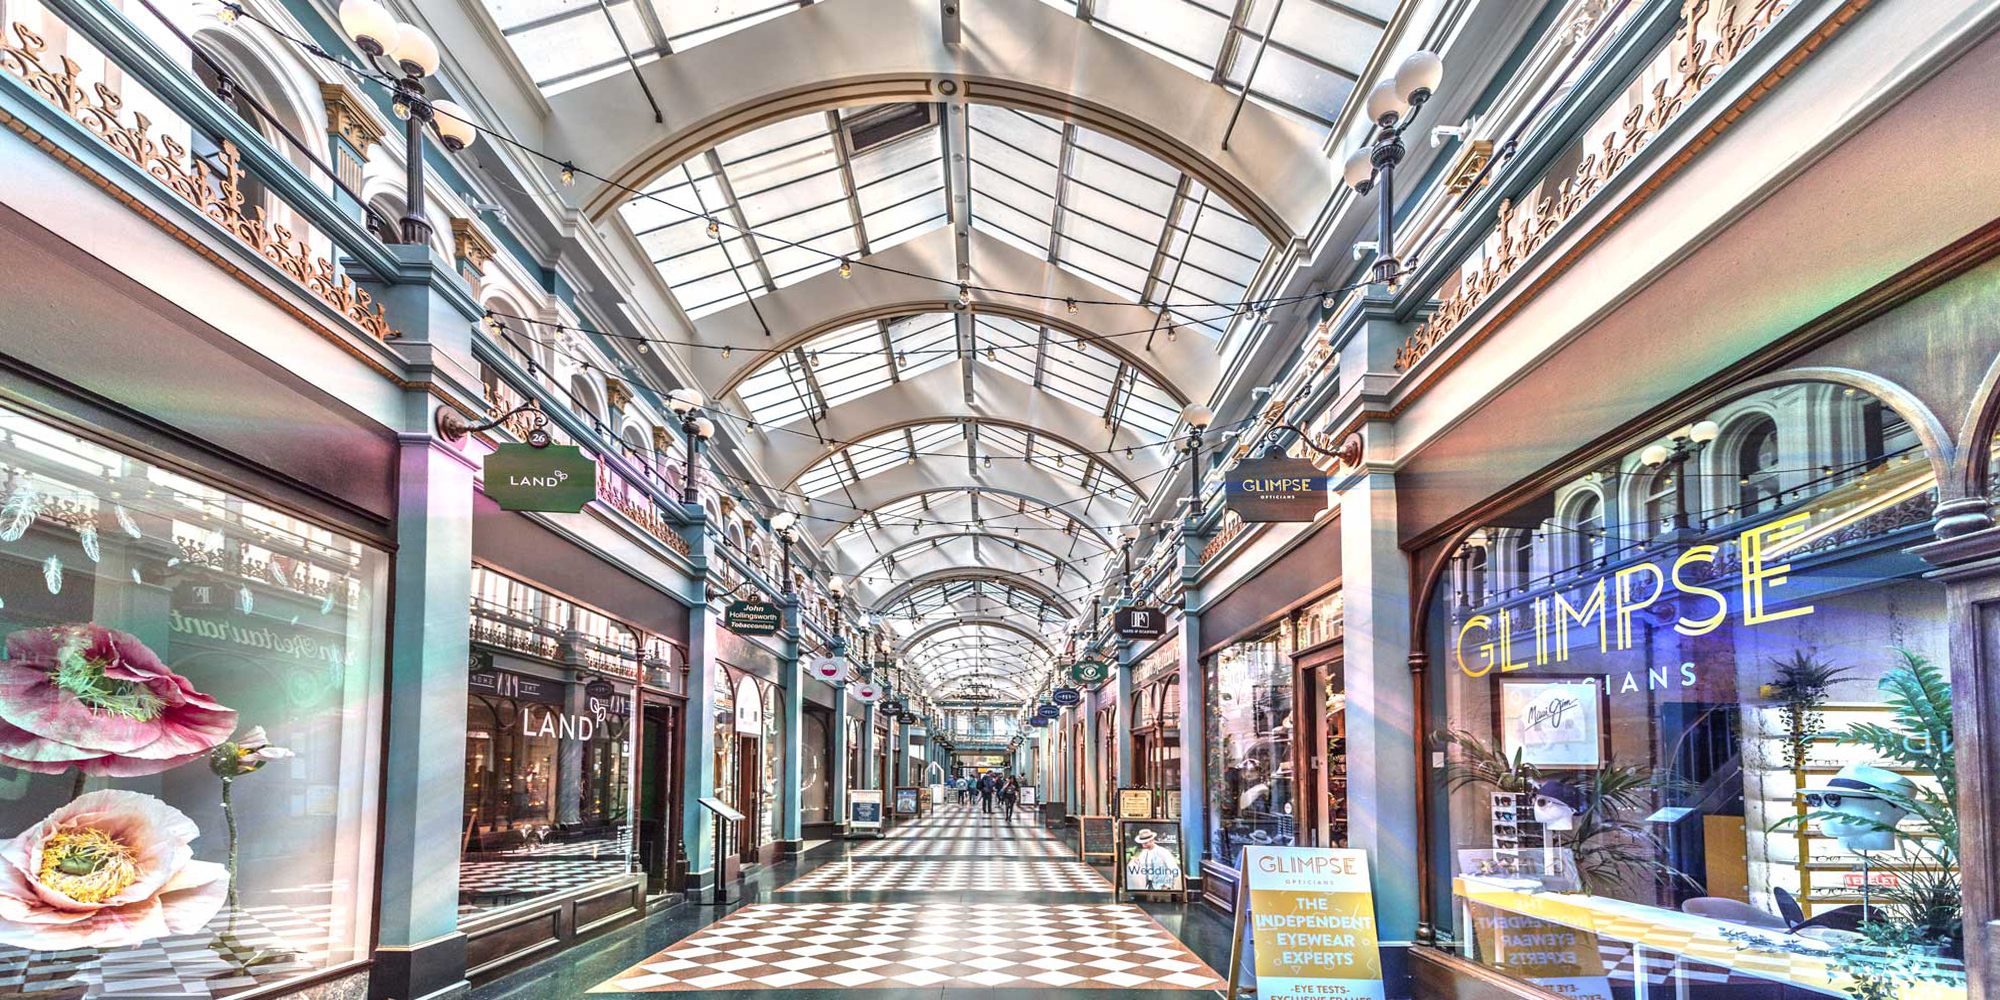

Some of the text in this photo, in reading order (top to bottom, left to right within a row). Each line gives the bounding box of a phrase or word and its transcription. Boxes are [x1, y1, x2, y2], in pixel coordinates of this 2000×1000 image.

[533, 433, 545, 443] 26
[510, 475, 558, 487] LAND
[1242, 478, 1312, 492] GLIMPSE
[1457, 512, 1814, 677] GLIMPSE
[743, 604, 764, 612] John
[729, 611, 778, 621] Hollingsworth
[1528, 705, 1548, 724] Maui
[523, 708, 593, 741] LAND
[1128, 865, 1179, 877] Wedding
[1258, 855, 1357, 875] GLIMPSE
[1295, 897, 1328, 911] THE
[1255, 914, 1371, 930] INDEPENDENT
[1276, 933, 1355, 947] EYEWEAR
[1282, 951, 1353, 966] EXPERTS
